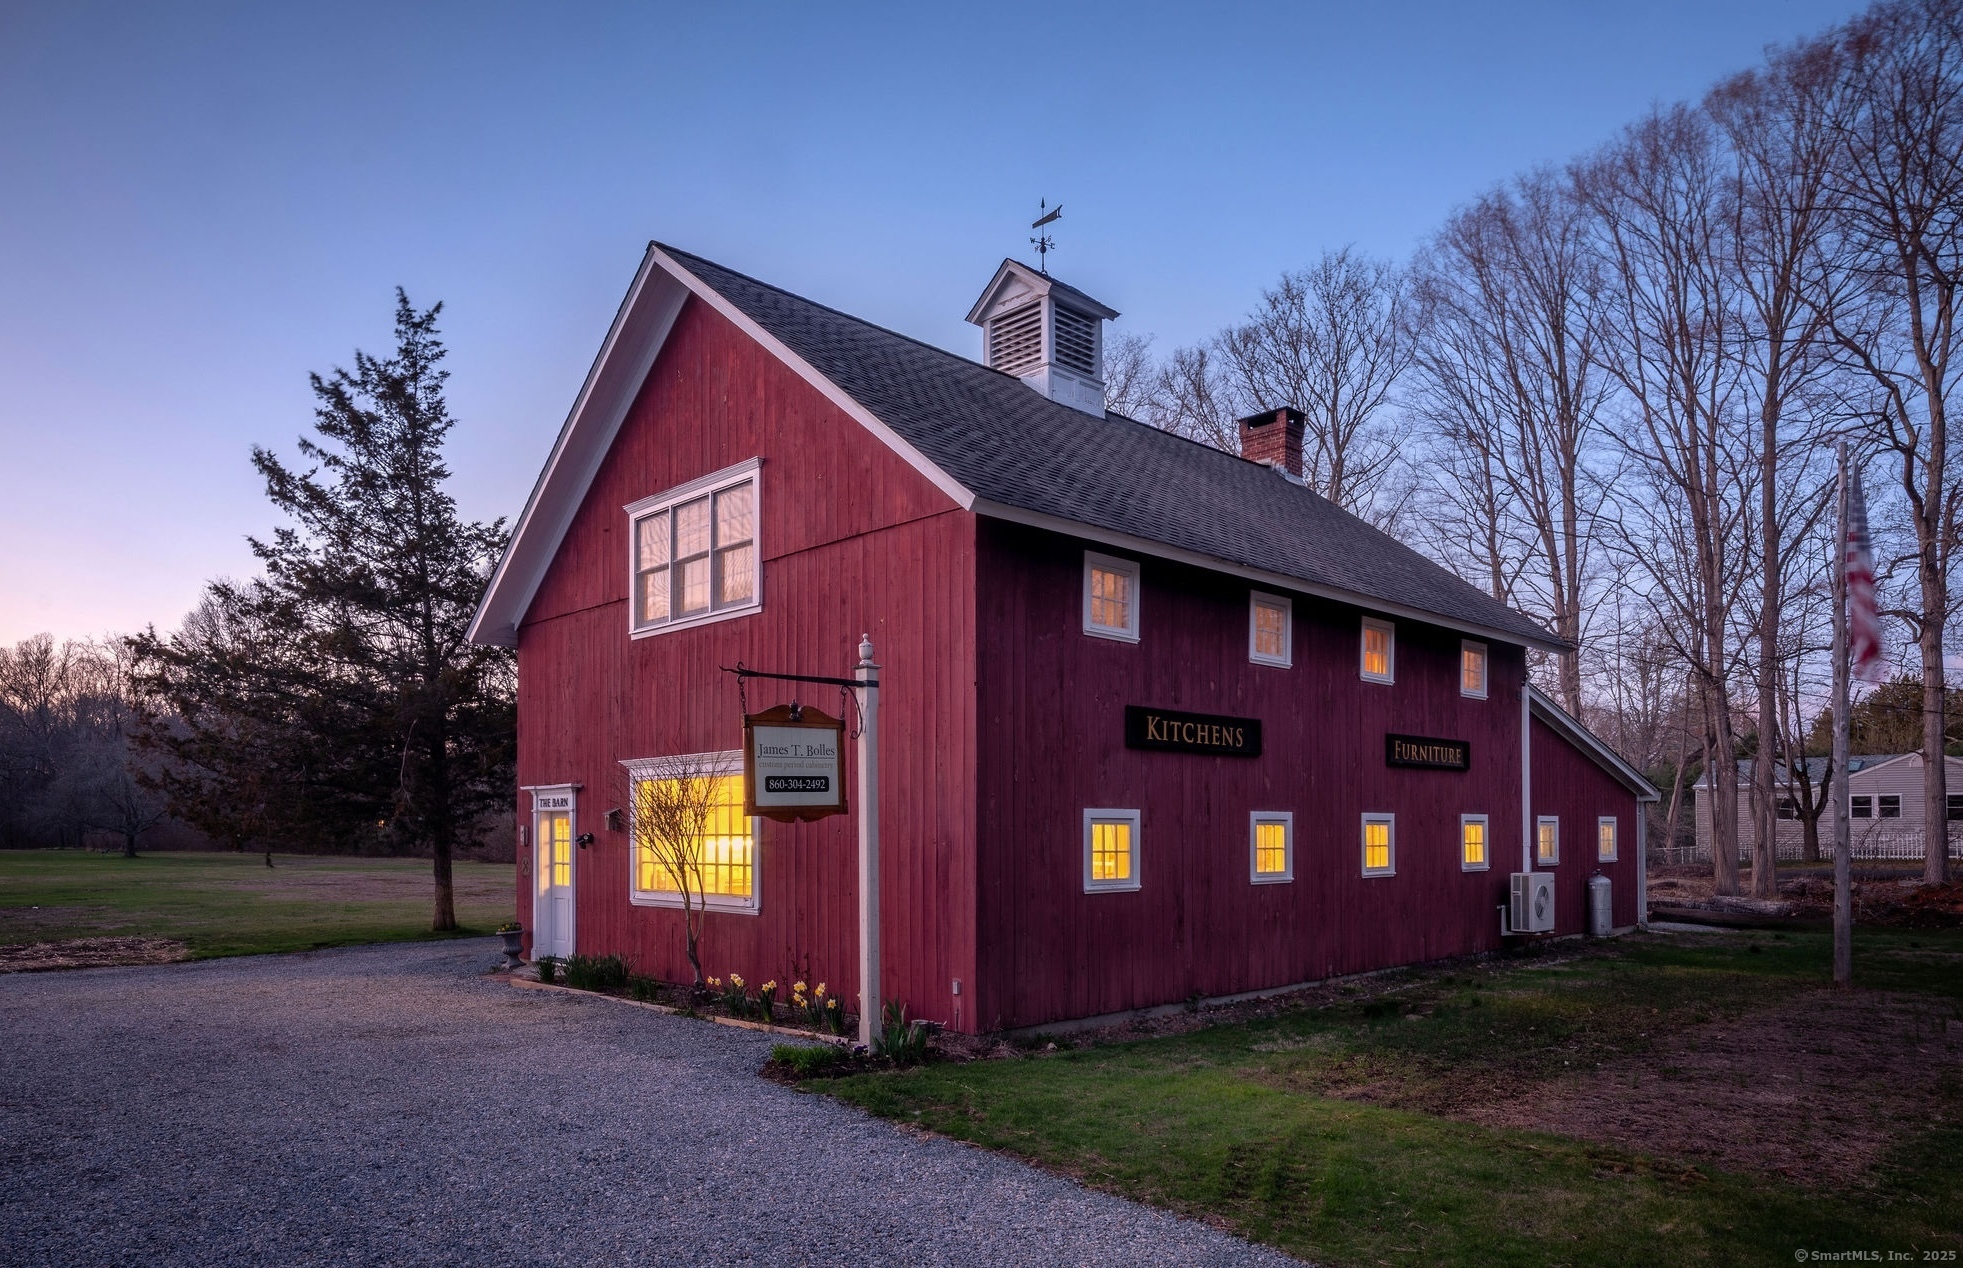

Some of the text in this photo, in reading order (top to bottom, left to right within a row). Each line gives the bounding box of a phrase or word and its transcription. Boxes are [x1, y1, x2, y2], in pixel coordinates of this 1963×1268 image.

[1146, 715, 1243, 748] KITCHENS
[757, 743, 835, 759] James T. Bolles
[1394, 740, 1462, 764] FURNITURE
[769, 779, 826, 790] 860-304-2492
[539, 797, 569, 808] THE BARN
